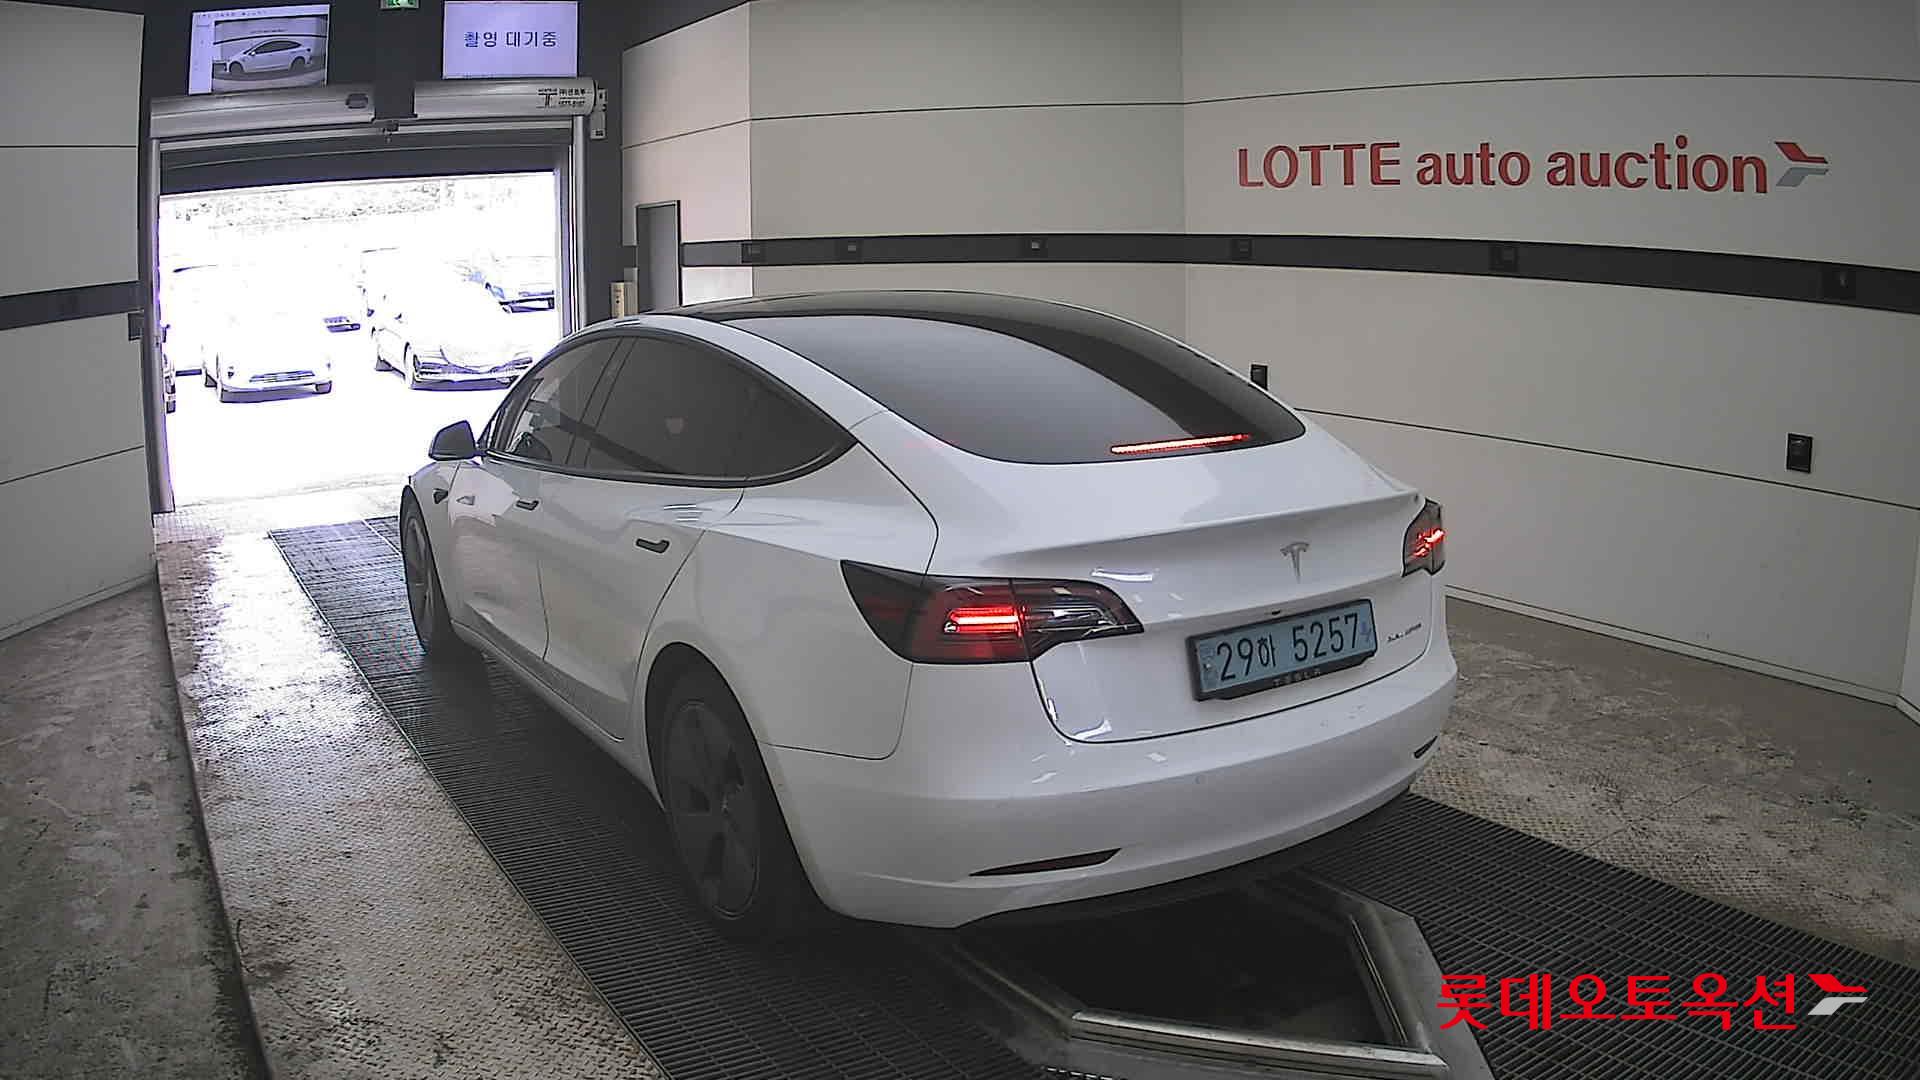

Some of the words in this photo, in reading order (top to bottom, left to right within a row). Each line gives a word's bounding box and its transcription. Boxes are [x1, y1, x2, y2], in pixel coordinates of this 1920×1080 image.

[465, 31, 497, 48] 촬영
[505, 31, 557, 48] 대기중
[1239, 142, 1400, 187] LOTTE
[1416, 142, 1530, 186] auto
[1546, 136, 1767, 193] auction
[1217, 634, 1276, 681] 29하
[1292, 613, 1358, 661] 5257
